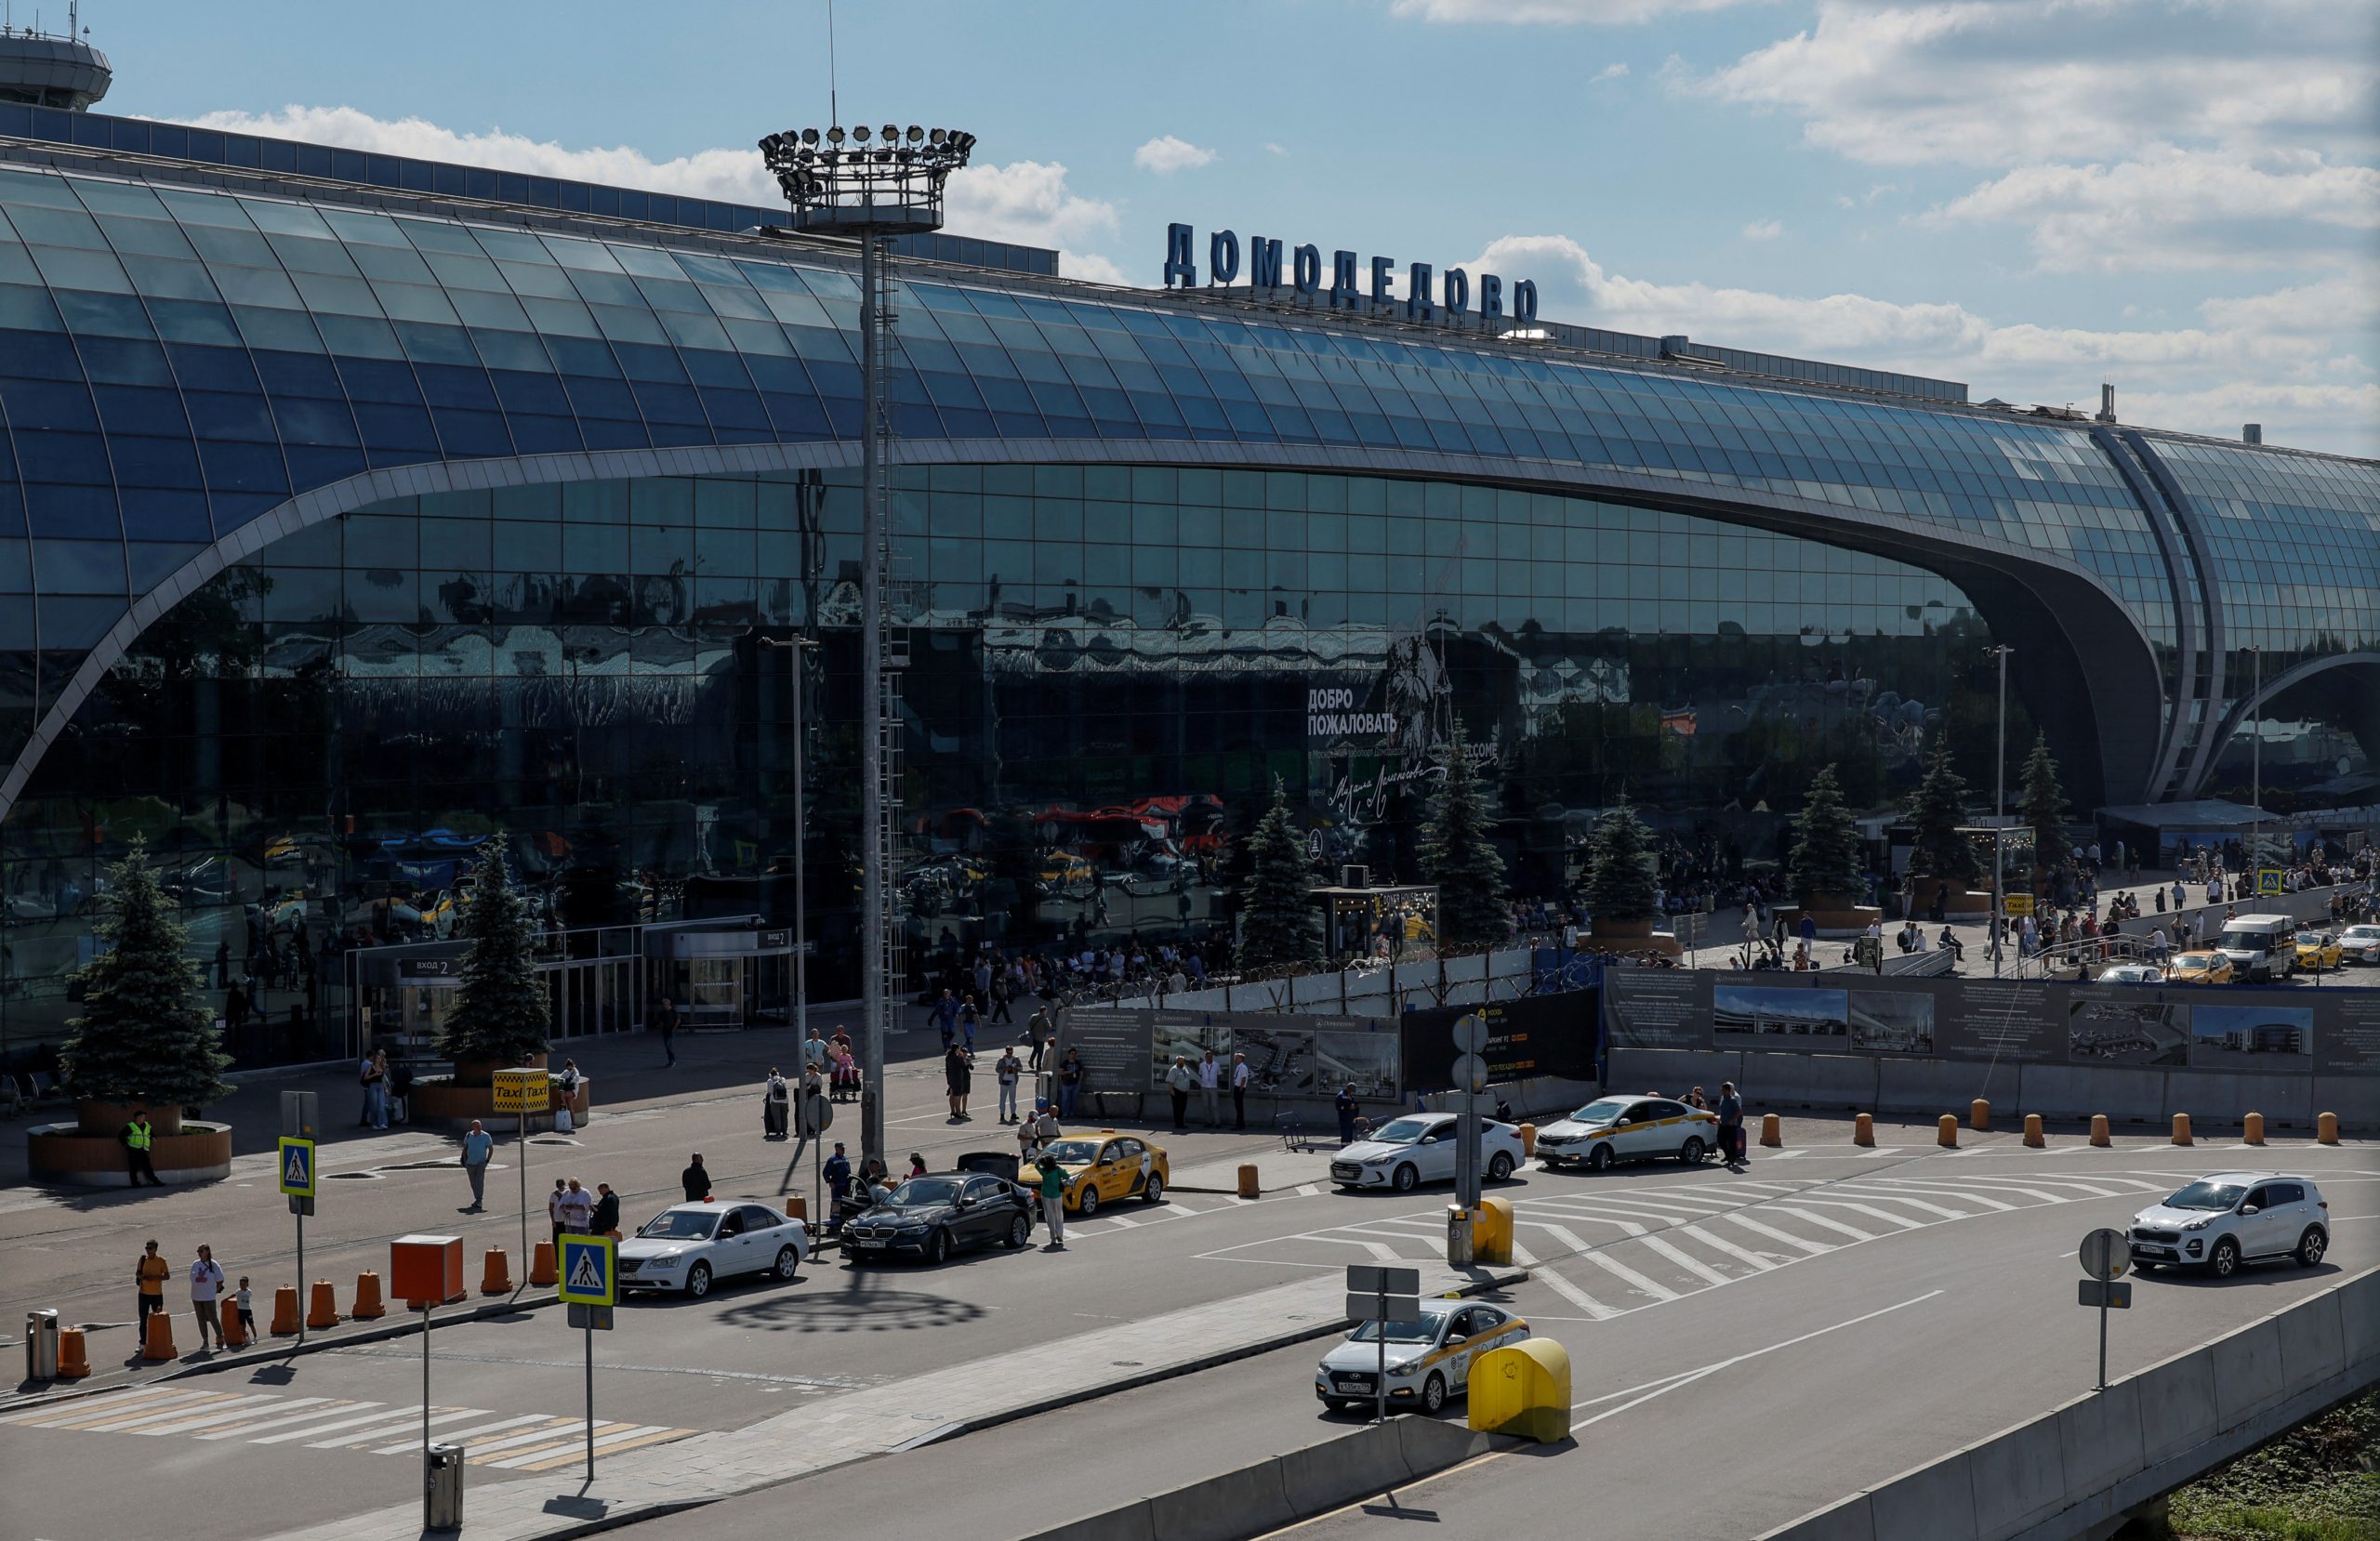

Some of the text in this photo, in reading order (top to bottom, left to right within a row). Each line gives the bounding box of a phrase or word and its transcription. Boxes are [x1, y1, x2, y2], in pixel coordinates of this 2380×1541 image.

[1164, 222, 1538, 325] ДОМОДЕДОВО
[1308, 689, 1353, 713] ДОБРО
[1308, 713, 1397, 735] ПОЖАЛОВАТЬ
[416, 961, 438, 969] ВХОД
[440, 961, 448, 975] 2
[496, 1087, 522, 1098] Taxi
[526, 1084, 548, 1098] Taxi
